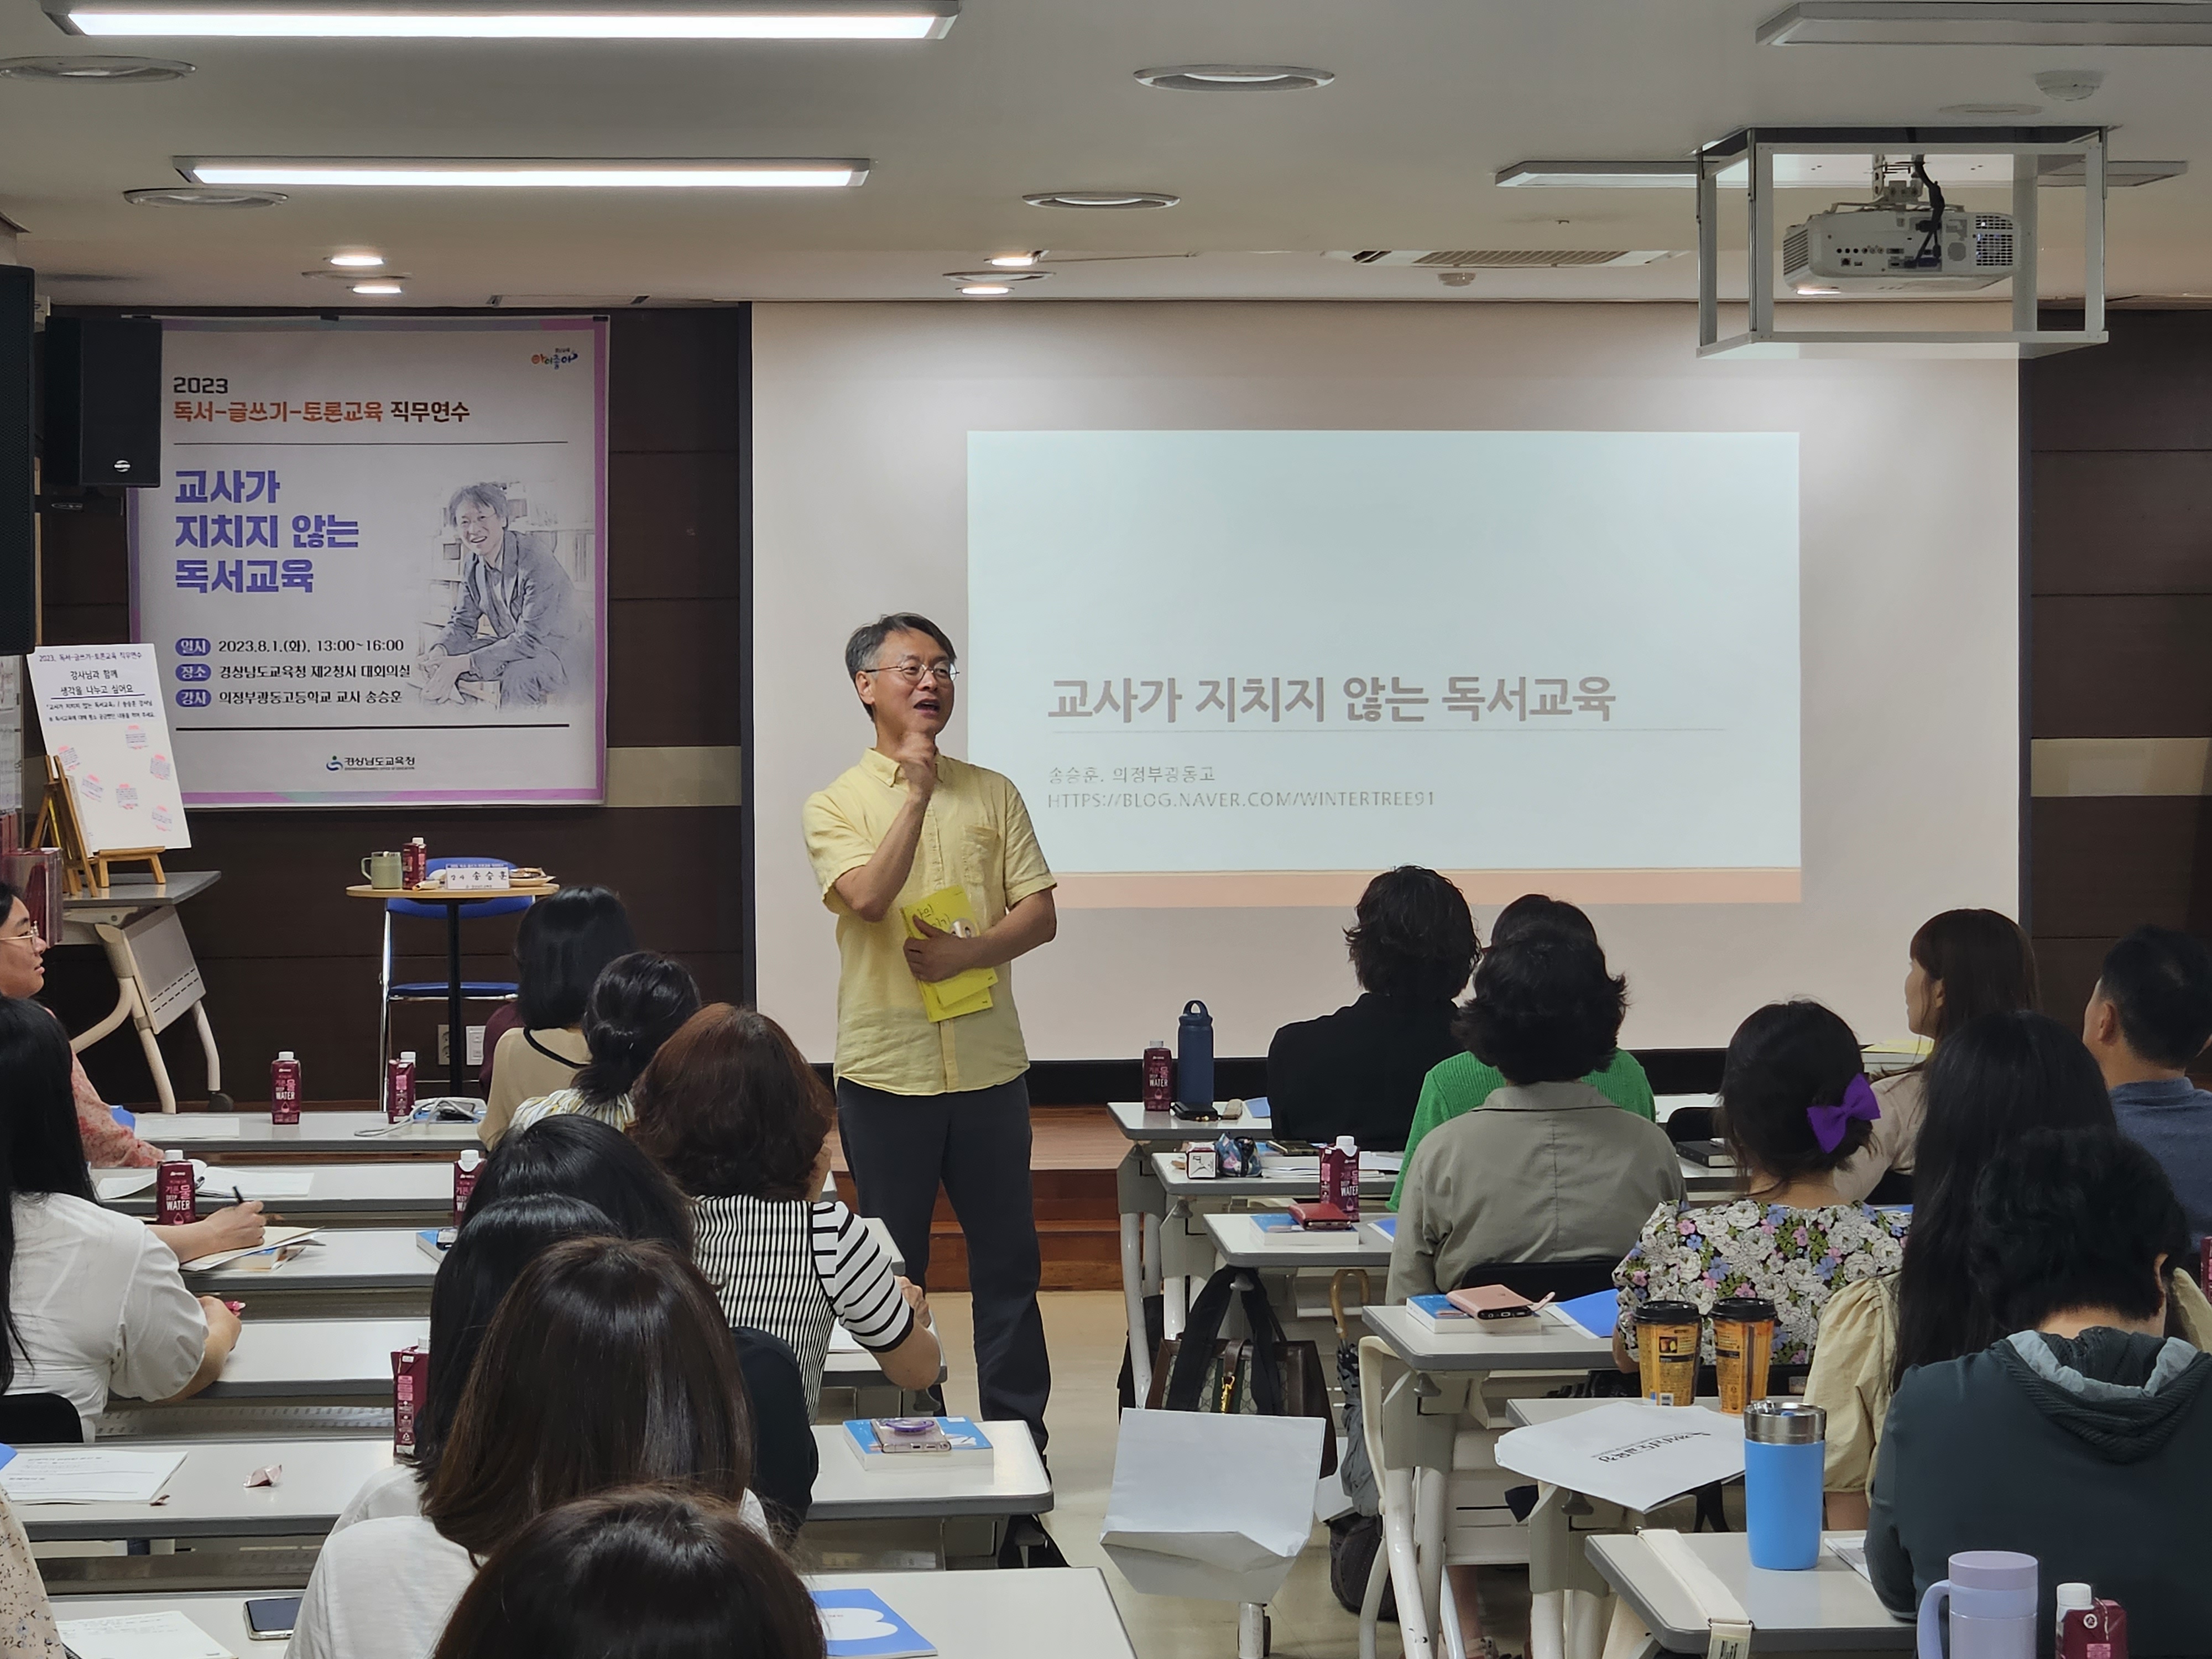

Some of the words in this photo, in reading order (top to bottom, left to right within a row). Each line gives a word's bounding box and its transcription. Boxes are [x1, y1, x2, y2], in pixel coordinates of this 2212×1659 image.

[173, 377, 228, 394] 2023
[173, 401, 384, 422] 독서-글쓰기-토론교육
[390, 401, 471, 422] 직무연수
[175, 470, 280, 503] 교사가
[175, 515, 278, 548] 지치지
[291, 514, 359, 548] 않는
[175, 559, 314, 593] 독서교육
[180, 639, 206, 654] 일시
[318, 639, 404, 651] 13:00~16:00
[70, 670, 100, 681] 강사님과
[103, 670, 118, 679] 함께
[180, 666, 207, 679] 장소
[219, 665, 306, 679] 경상남도교육청
[310, 665, 357, 678] 제2청사
[361, 665, 411, 678] 대회의실
[60, 686, 82, 696] 생각을
[86, 686, 108, 695] 나누고
[111, 684, 133, 694] 싶어요
[180, 691, 207, 705] 강사
[219, 691, 332, 705] 의정부광동고등학교
[336, 690, 360, 703] 교사
[366, 690, 403, 703] 송승훈
[1048, 677, 1183, 723] 교사가
[1195, 677, 1324, 723] 지치지
[1343, 676, 1430, 722] 않는
[1441, 676, 1616, 722] 독서교육
[344, 756, 416, 766] 경상남도교육청
[1113, 766, 1216, 784] 의정부광동고
[1047, 792, 1434, 808] HTTPS://BLOG.NAVER.COM/WINTERTREE91
[1149, 1079, 1168, 1087] WATER
[166, 1200, 190, 1211] WATER
